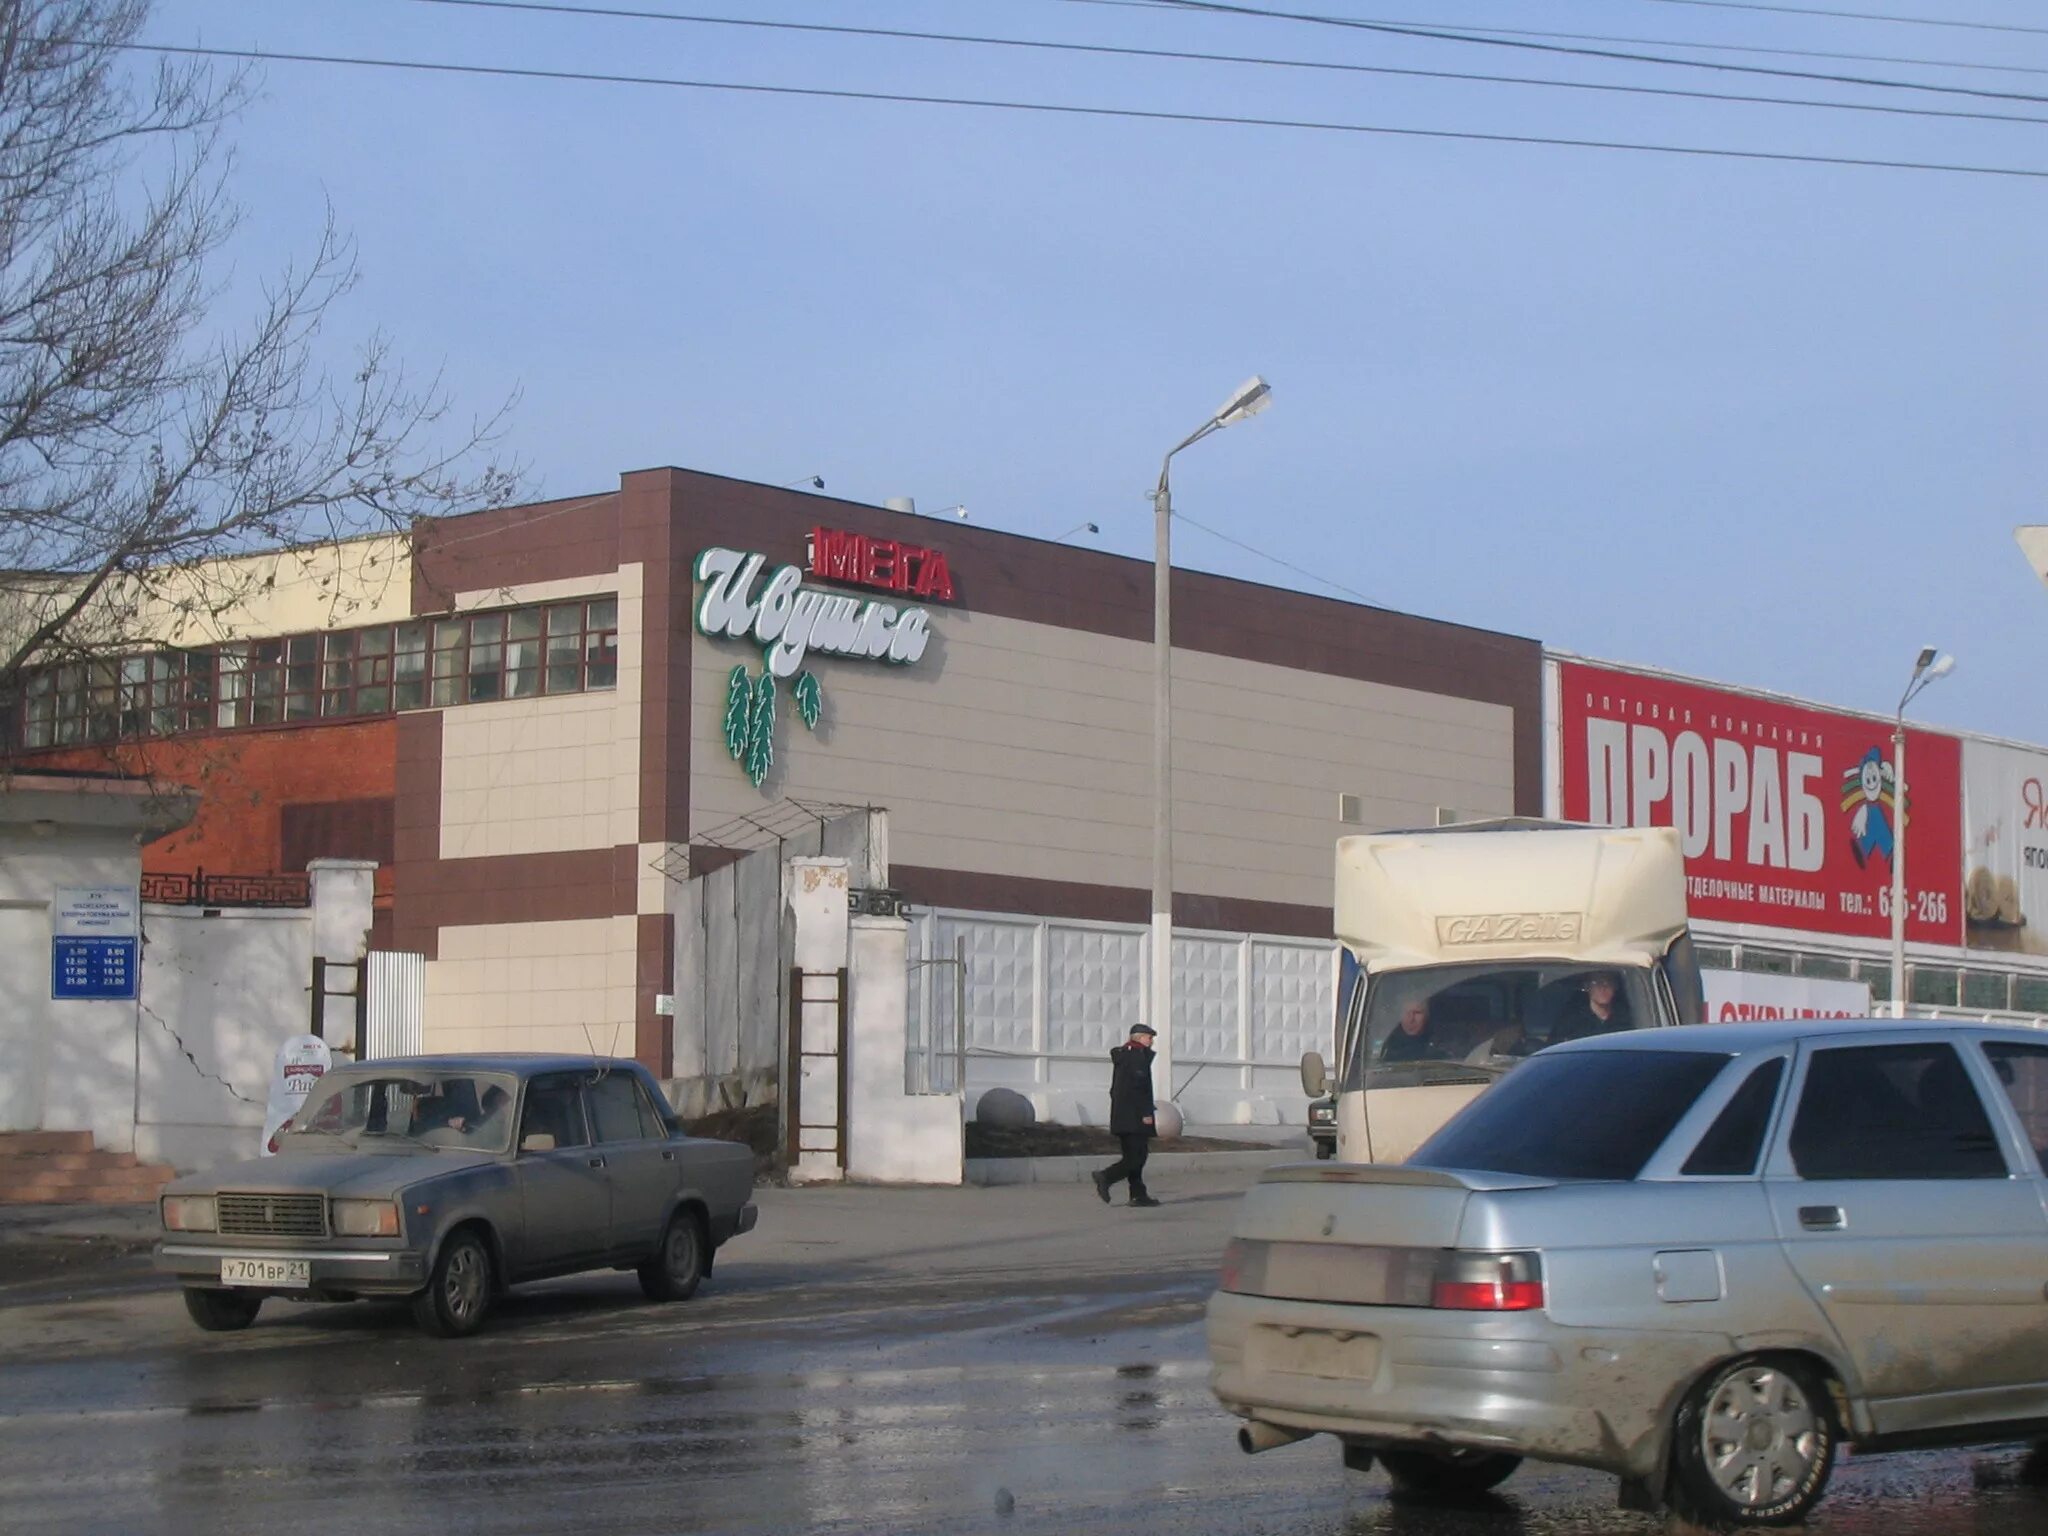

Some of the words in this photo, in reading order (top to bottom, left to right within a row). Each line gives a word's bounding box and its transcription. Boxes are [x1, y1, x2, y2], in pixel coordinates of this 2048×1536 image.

[812, 527, 954, 600] МЕГА
[694, 546, 931, 678] Ивушка
[1586, 692, 1692, 725] ОПТОВАЯ
[1710, 714, 1824, 749] КОМПАНИЯ
[1586, 716, 1825, 873] ПРОРАБ
[2023, 845, 2048, 871] ЯПО
[1685, 875, 1754, 902] ТДЕЛОЧНЫЕ
[1758, 884, 1826, 911] МАТЕРИАЛЫ
